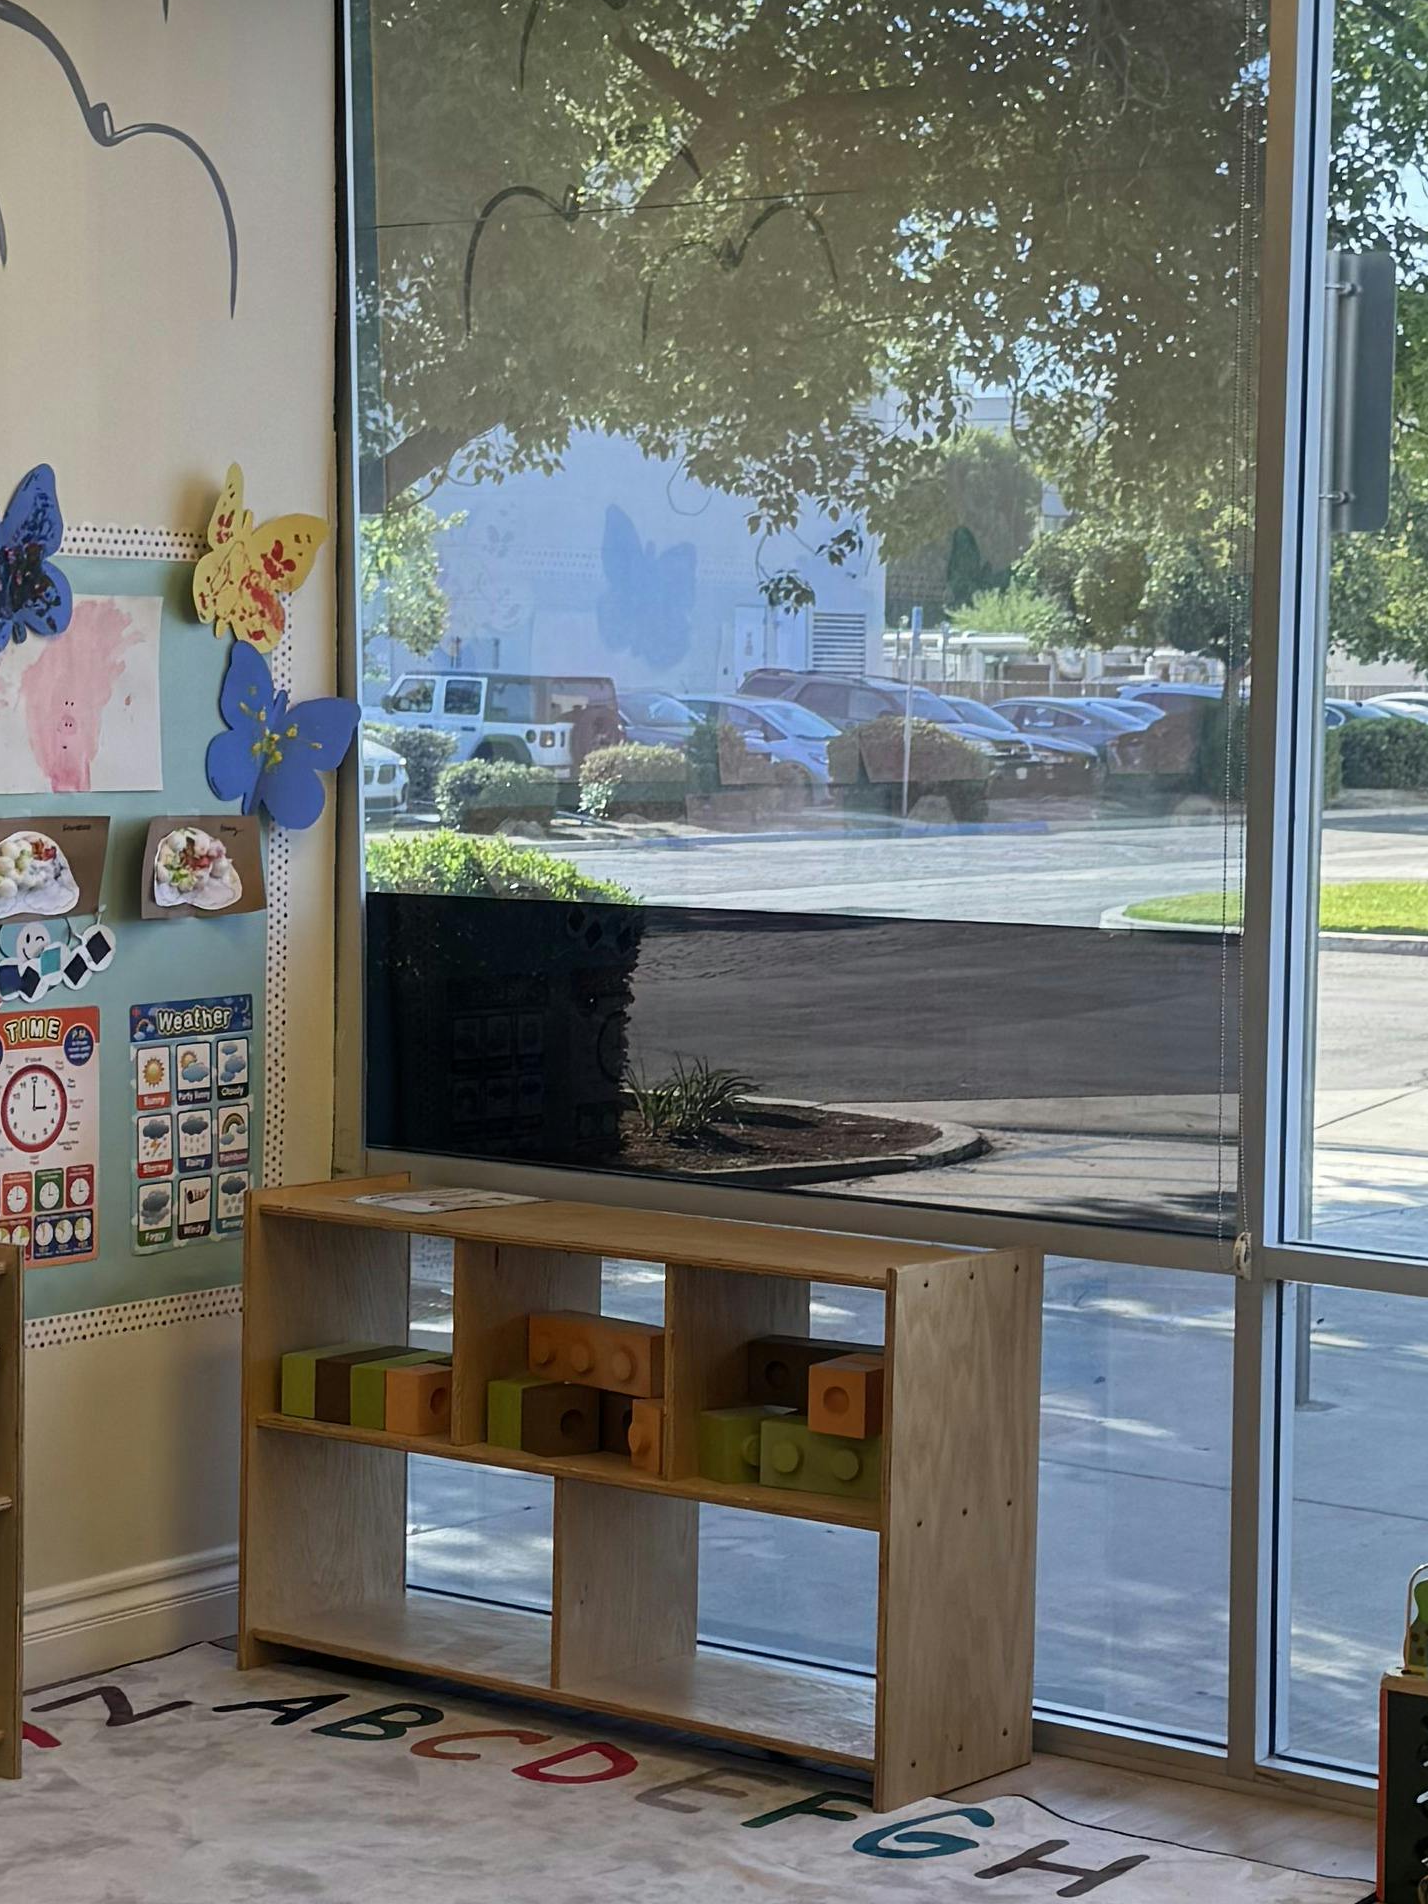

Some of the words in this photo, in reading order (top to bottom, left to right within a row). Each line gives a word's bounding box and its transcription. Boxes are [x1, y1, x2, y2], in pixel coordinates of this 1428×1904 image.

[4, 1017, 62, 1044] TIME
[156, 1005, 232, 1034] Weather
[220, 1085, 244, 1097] Cloudy
[211, 1694, 351, 1726] A
[310, 1703, 445, 1741] B
[409, 1729, 554, 1762] C
[510, 1741, 639, 1785] D
[852, 1806, 997, 1859] G
[973, 1838, 1151, 1898] H
